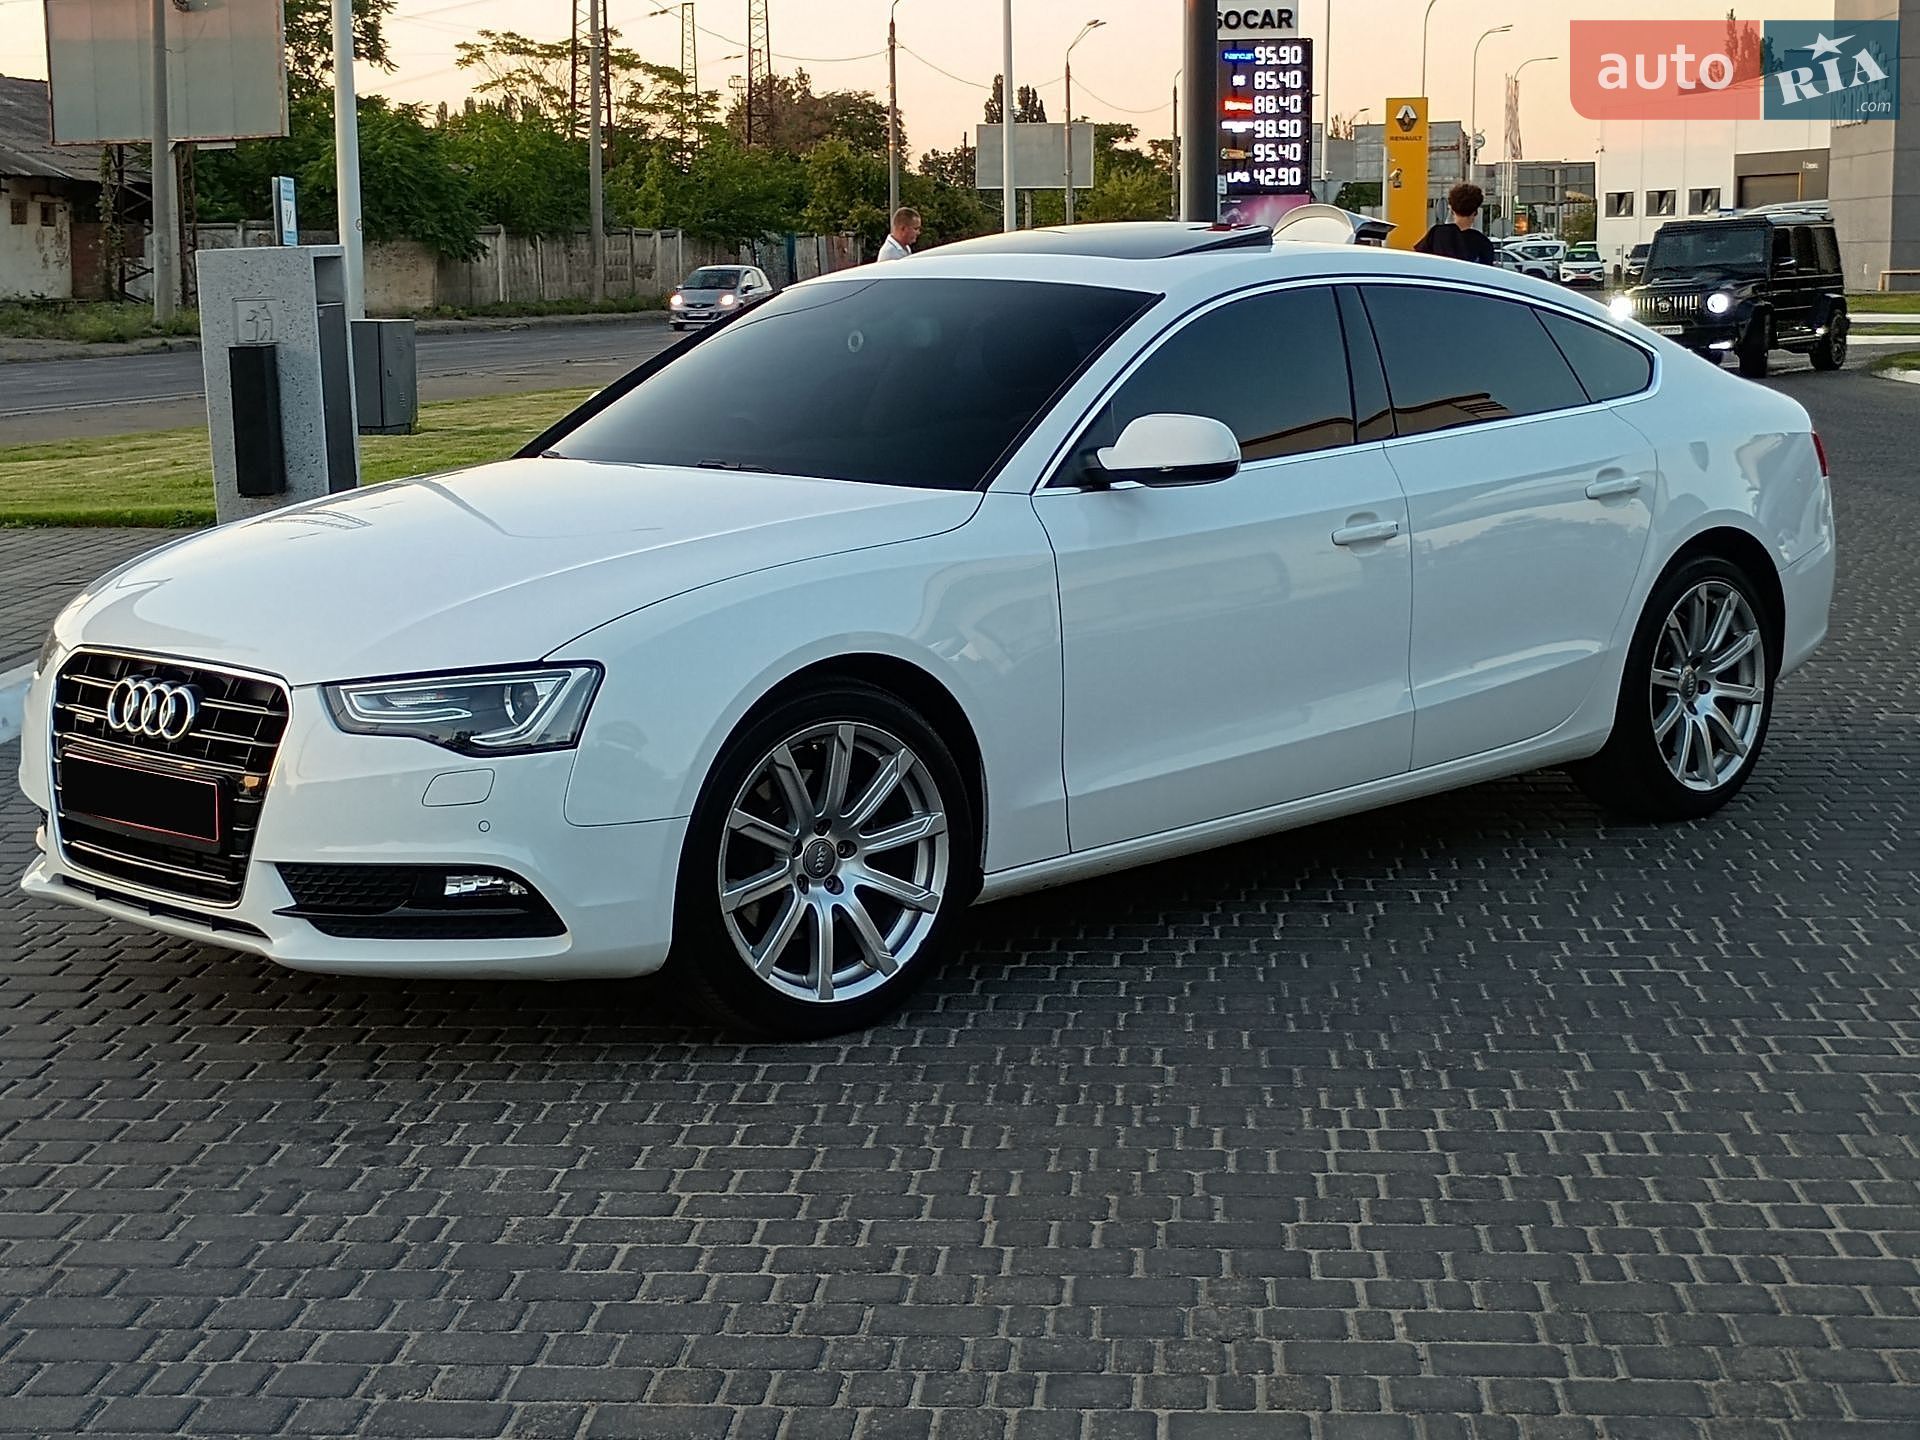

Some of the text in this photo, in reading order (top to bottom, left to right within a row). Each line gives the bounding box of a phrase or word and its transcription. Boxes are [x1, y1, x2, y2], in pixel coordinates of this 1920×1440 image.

[1254, 46, 1302, 65] 95.90
[1254, 71, 1302, 90] 85.40
[1253, 119, 1302, 138] 98.90
[1253, 143, 1302, 162] 95.40
[1253, 167, 1301, 186] 42.90
